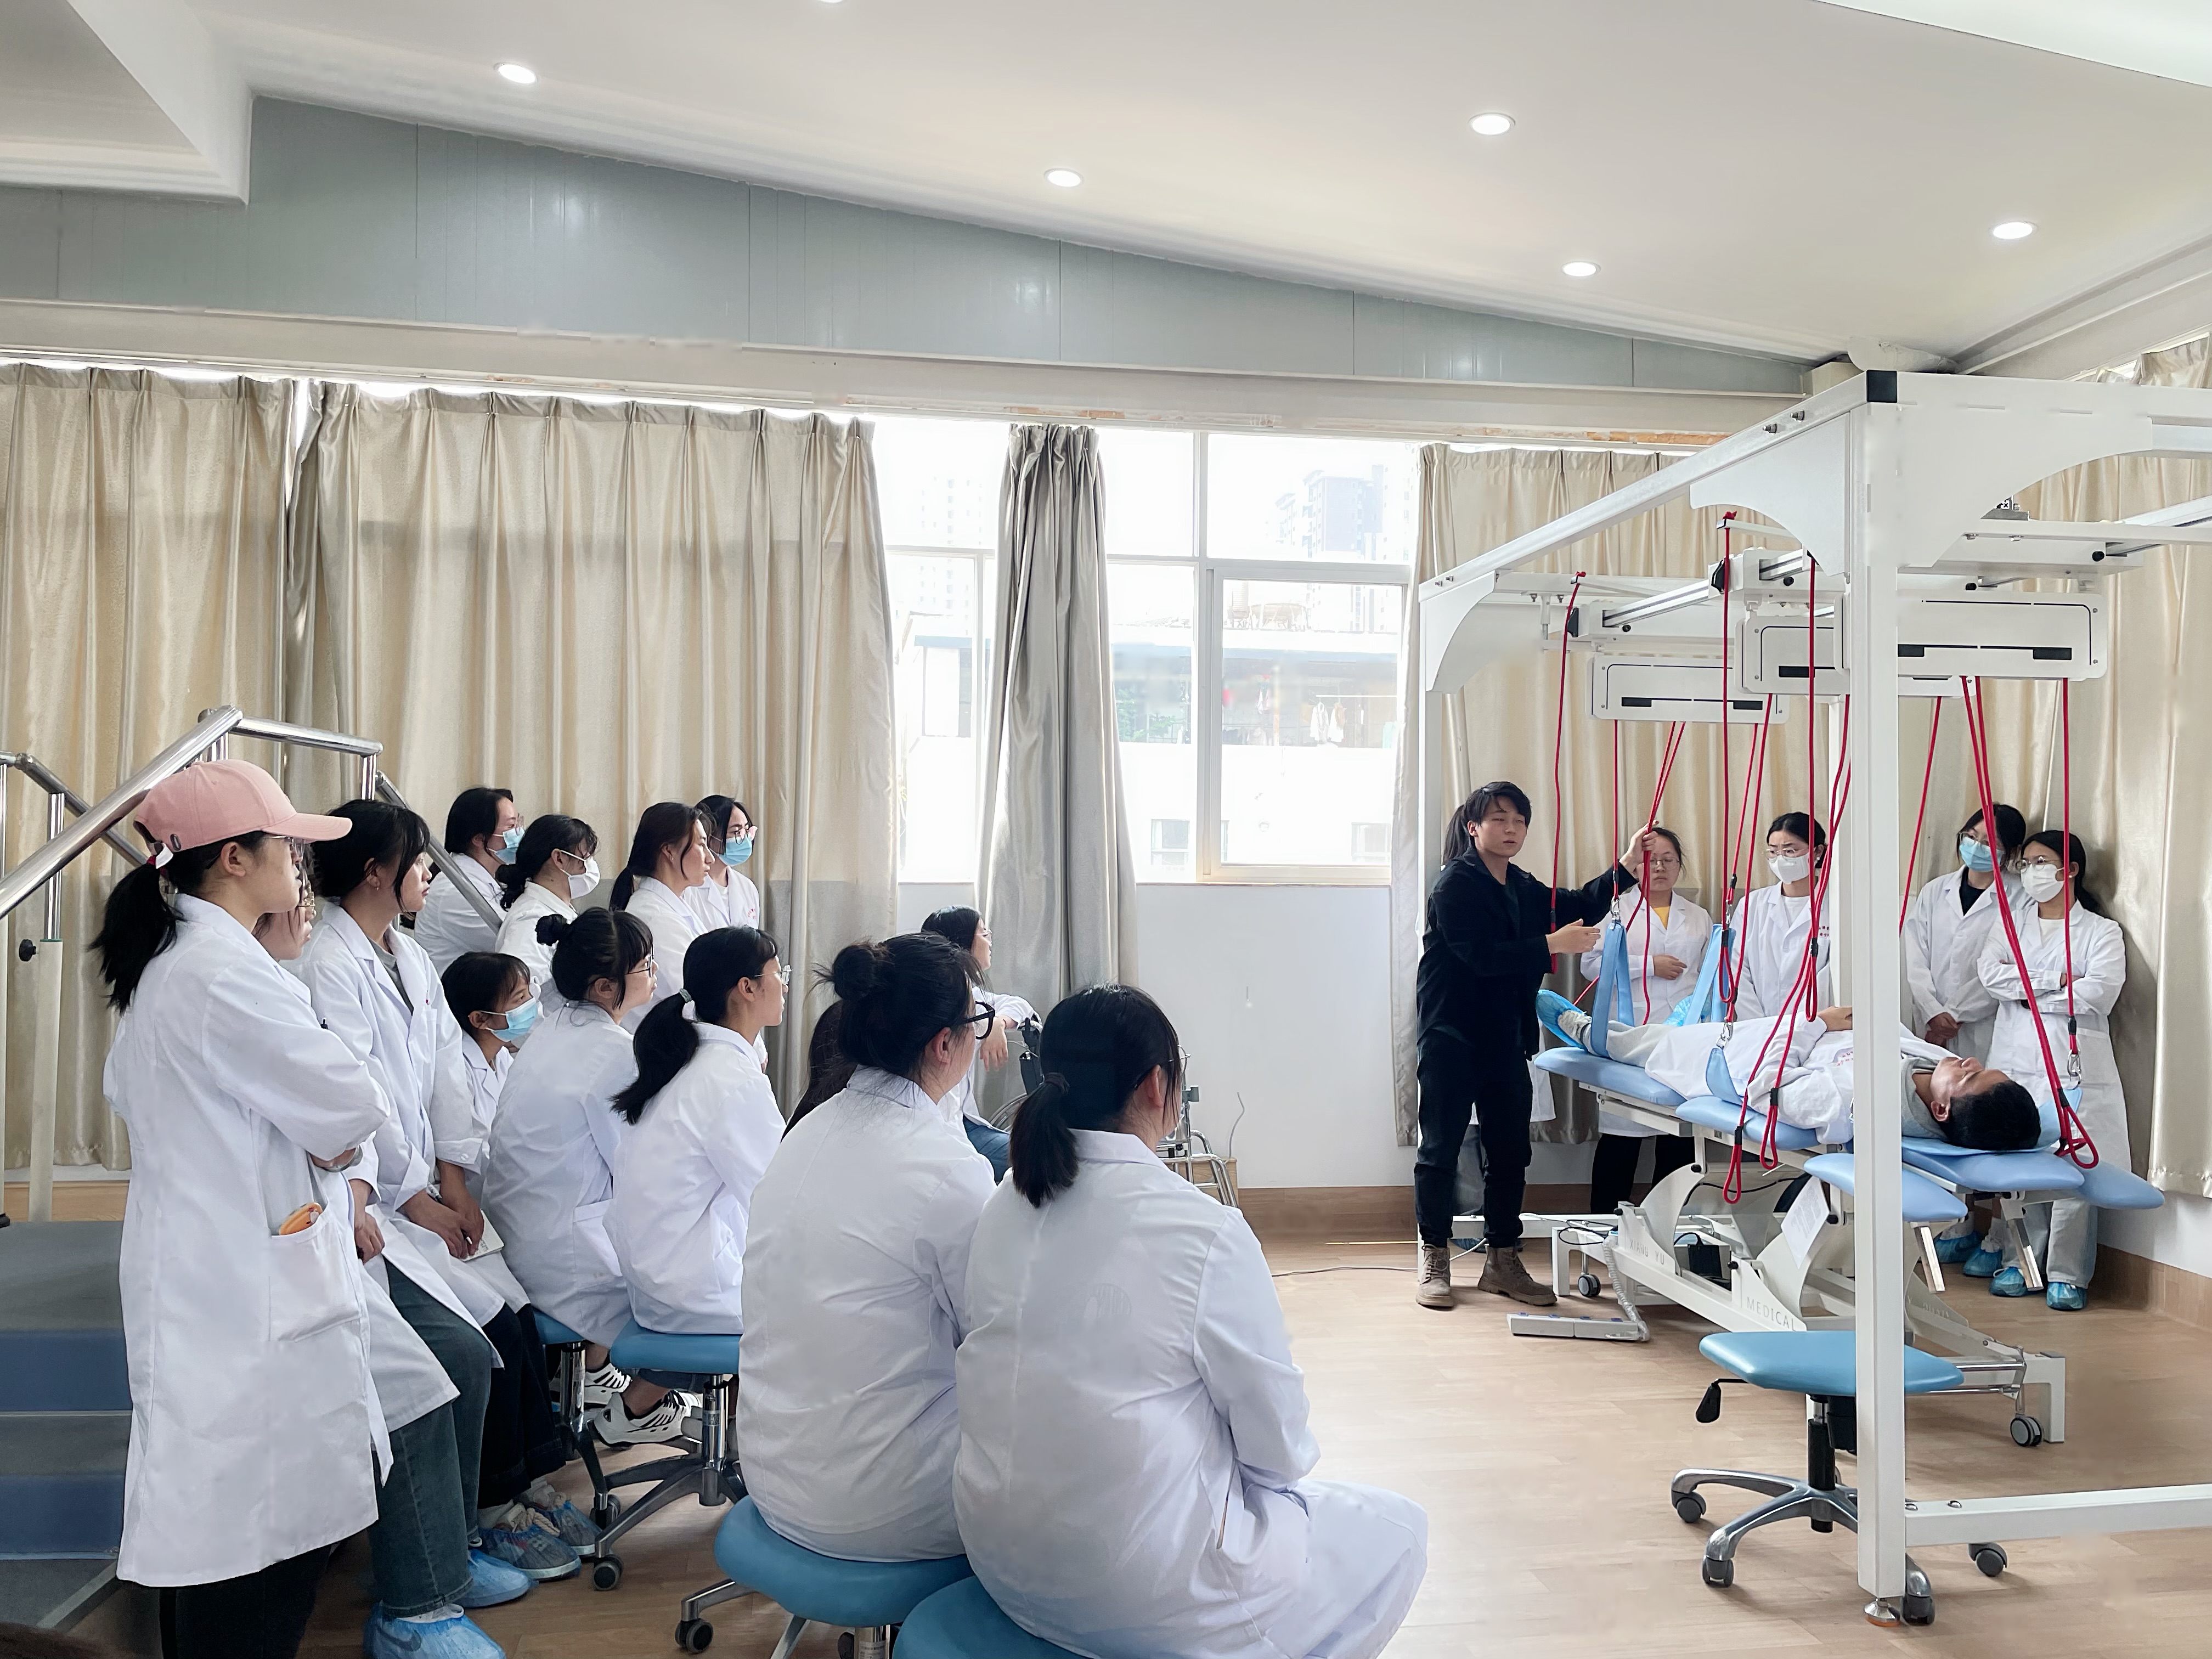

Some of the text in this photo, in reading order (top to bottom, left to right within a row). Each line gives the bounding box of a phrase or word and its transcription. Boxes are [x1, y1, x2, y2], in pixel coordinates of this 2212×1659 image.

[1629, 1239, 1664, 1265] XIANG YU
[1747, 1296, 1797, 1331] MEDICAL
